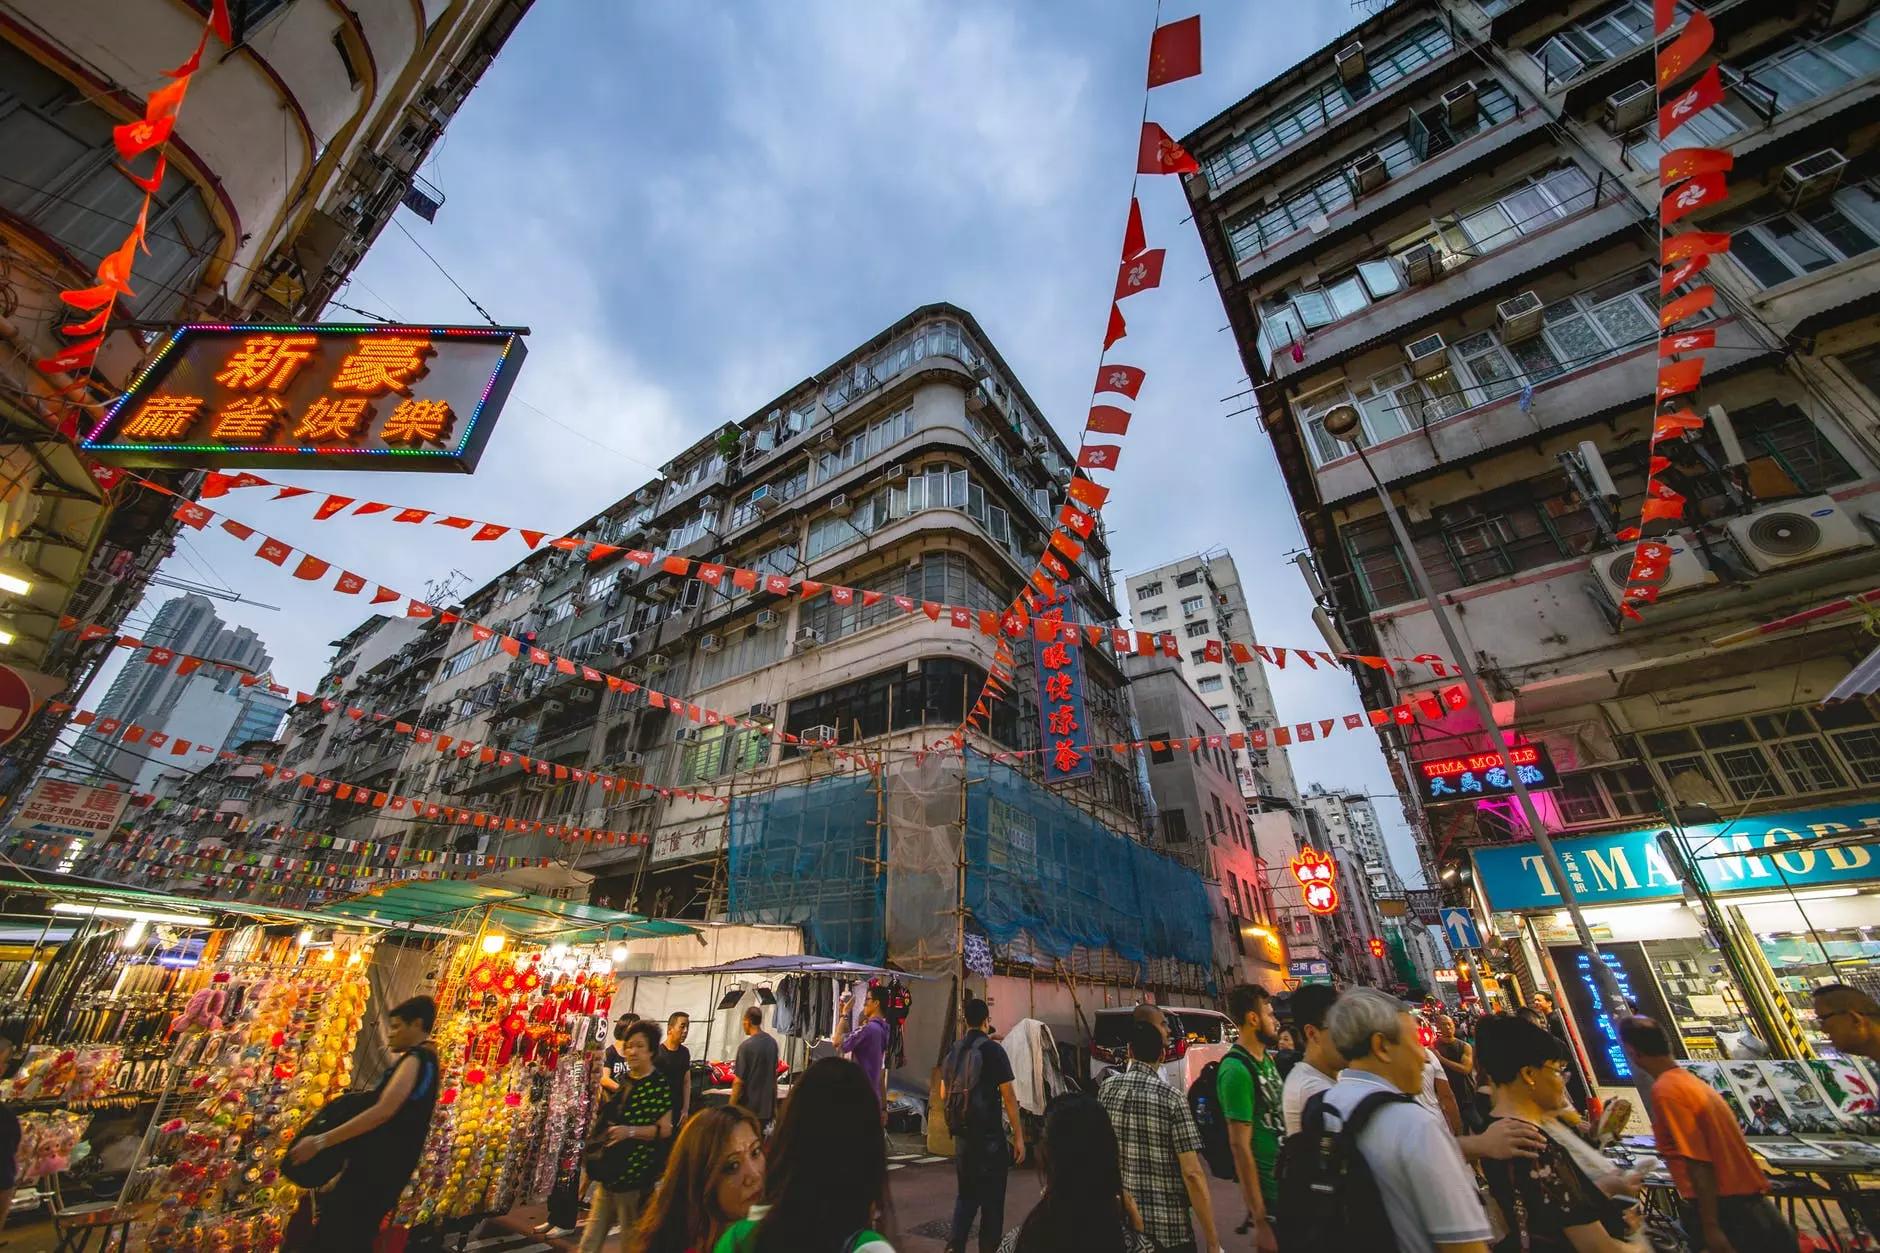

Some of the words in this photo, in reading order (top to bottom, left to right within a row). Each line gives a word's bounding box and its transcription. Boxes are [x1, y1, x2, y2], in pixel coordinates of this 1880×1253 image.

[215, 336, 436, 391] 新豪
[1424, 760, 1467, 777] TIMA
[1469, 749, 1536, 769] MOLE
[1430, 765, 1545, 797] 天馬電訊
[1713, 817, 1880, 881] MOB
